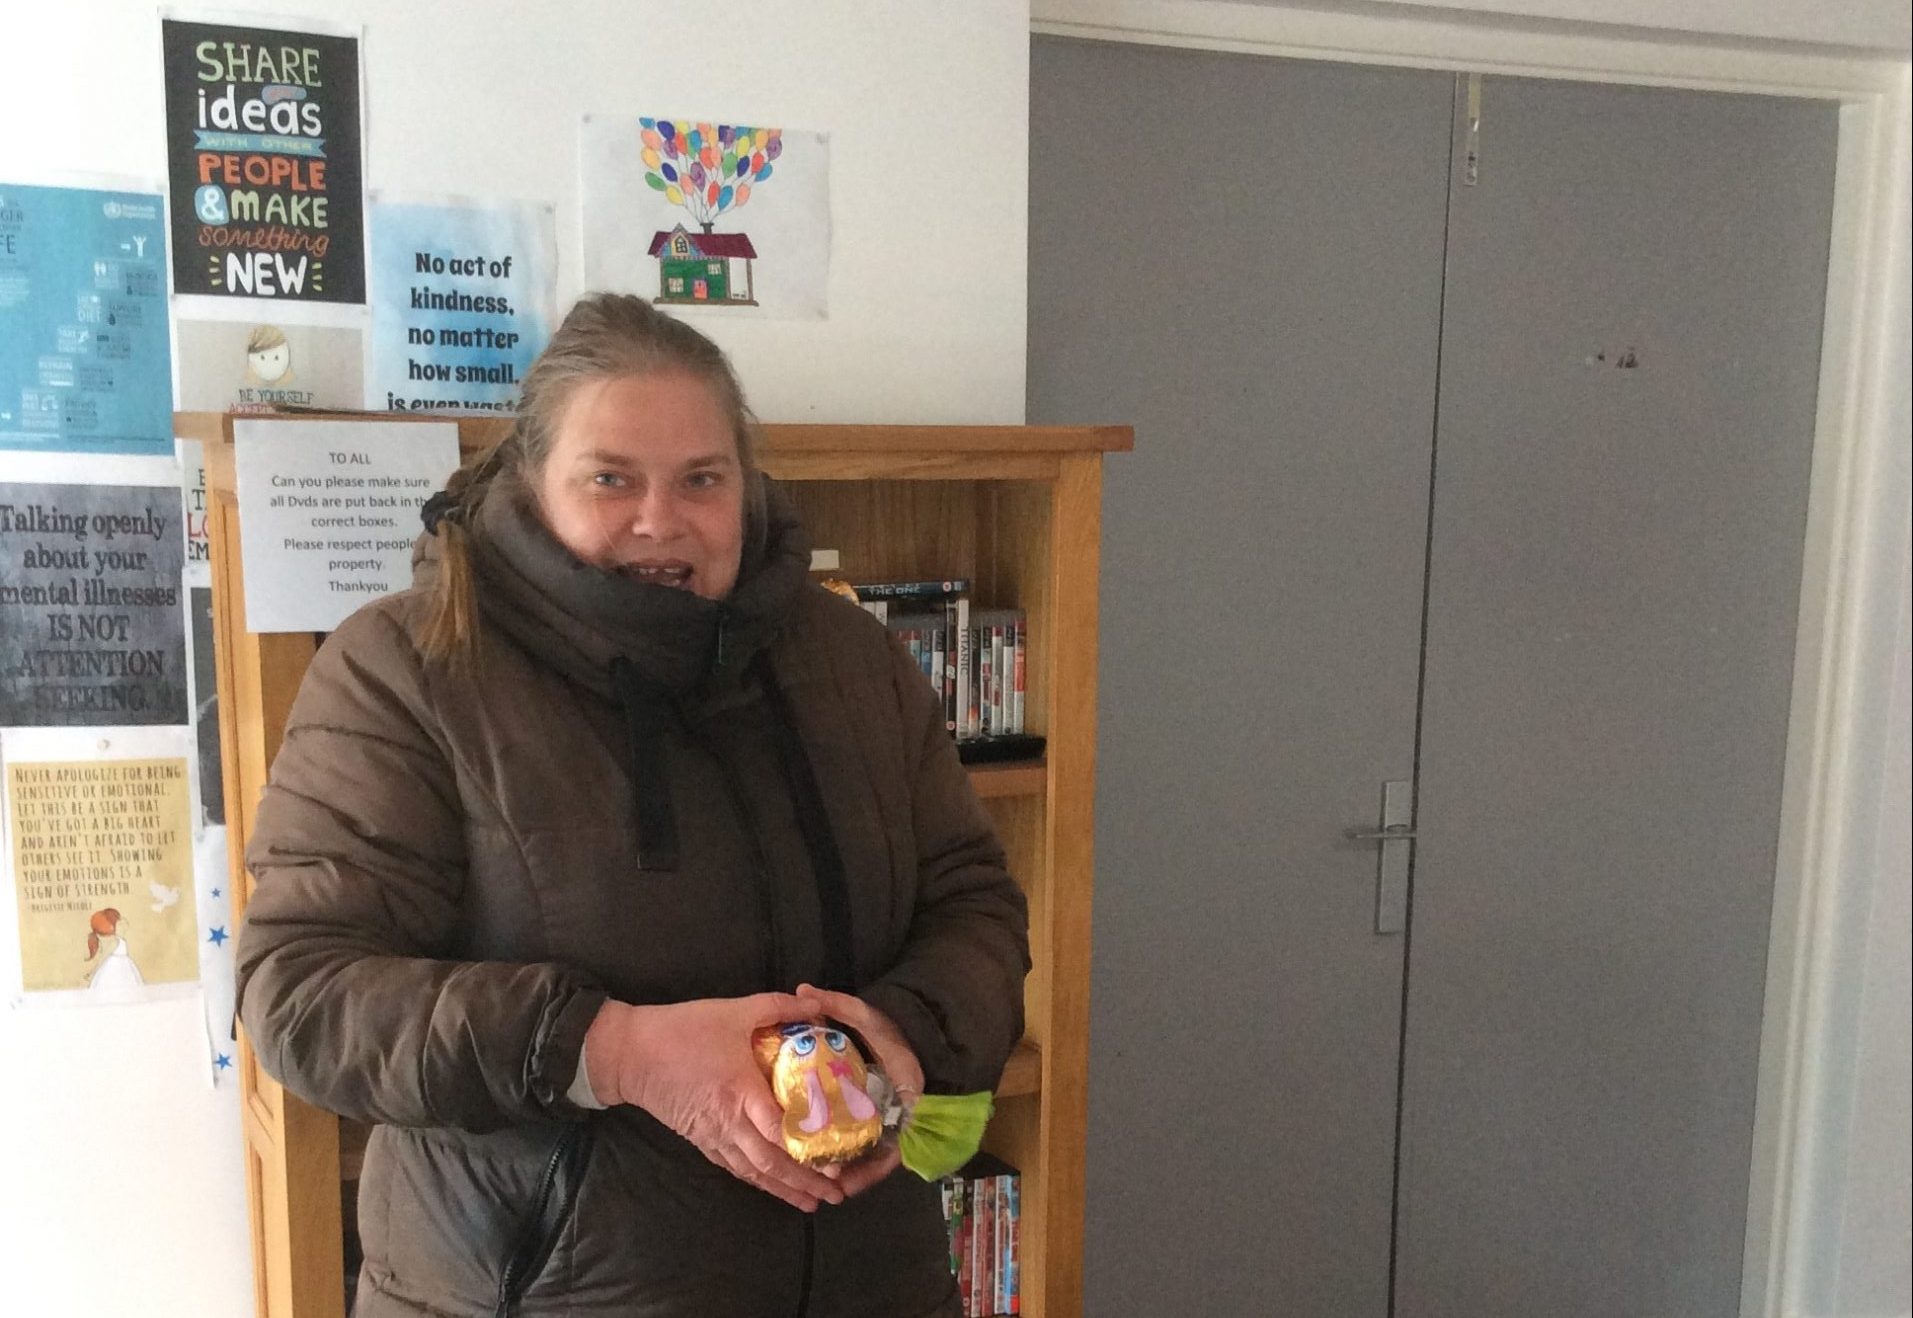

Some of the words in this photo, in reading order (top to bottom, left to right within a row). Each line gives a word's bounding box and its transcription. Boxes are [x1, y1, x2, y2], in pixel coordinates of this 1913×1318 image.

[196, 41, 322, 87] SHARE
[197, 84, 322, 137] ideas
[204, 137, 248, 148] WITH
[261, 138, 313, 151] OTHER
[197, 153, 326, 191] PEOPLE
[202, 188, 225, 221] &
[231, 189, 329, 229] MAKE
[199, 225, 330, 258] something
[226, 252, 308, 296] NEW
[415, 252, 445, 274] No
[449, 256, 486, 277] act
[489, 256, 512, 278] of
[408, 327, 435, 345] no
[440, 328, 519, 349] matter
[408, 359, 451, 382] how
[387, 391, 406, 411] is
[329, 452, 347, 465] TO
[350, 453, 371, 465] ALL
[271, 475, 295, 488] Can
[299, 478, 322, 489] you
[325, 476, 365, 489] please
[368, 476, 401, 488] make
[404, 478, 430, 489] sure
[270, 496, 285, 507] all
[288, 496, 318, 507] Dvds
[321, 498, 342, 507] are
[345, 496, 365, 509] put
[369, 496, 397, 507] back
[400, 496, 412, 507] in
[414, 496, 427, 508] th
[0, 504, 89, 541] Talking
[92, 504, 167, 541] openly
[311, 517, 355, 528] correct
[358, 516, 398, 528] boxes.
[284, 538, 324, 550] Please
[327, 539, 372, 552] respect
[23, 542, 90, 569] about
[94, 550, 148, 576] your
[0, 578, 79, 605] mental
[83, 578, 177, 606] illnesses
[328, 580, 388, 593] Thankyou
[868, 586, 892, 596] THE
[47, 613, 72, 642] IS
[78, 613, 130, 642] NOT
[960, 628, 970, 677] TITANIC
[16, 650, 165, 678] ATTENTION
[56, 767, 118, 782] APOLOGIZE
[123, 766, 143, 780] FOR
[147, 765, 181, 780] BEING
[16, 785, 77, 800] SENSITIVE
[82, 784, 96, 798] OR
[18, 803, 36, 817] LET
[42, 802, 67, 815] THIS
[71, 801, 83, 815] BE
[88, 801, 96, 814] A
[100, 800, 128, 814] SIGN
[133, 800, 160, 813] THAT
[19, 818, 61, 833] YOU'VE
[66, 817, 87, 831] GOT
[92, 817, 99, 830] A
[104, 817, 124, 830] BIG
[128, 815, 161, 829] HEART
[21, 836, 44, 850] AND
[49, 833, 89, 849] AREN'T
[94, 833, 136, 847] AFRAID
[141, 832, 153, 845] TO
[157, 831, 176, 845] LET
[21, 852, 61, 866] OTHERS
[66, 852, 83, 865] SEE
[110, 848, 163, 863] SHOWING
[23, 868, 52, 883] YOUR
[56, 866, 115, 881] EMOTIONS
[119, 865, 132, 878] IS
[135, 865, 143, 878] A
[24, 885, 52, 900] SIGN
[57, 884, 70, 898] OF
